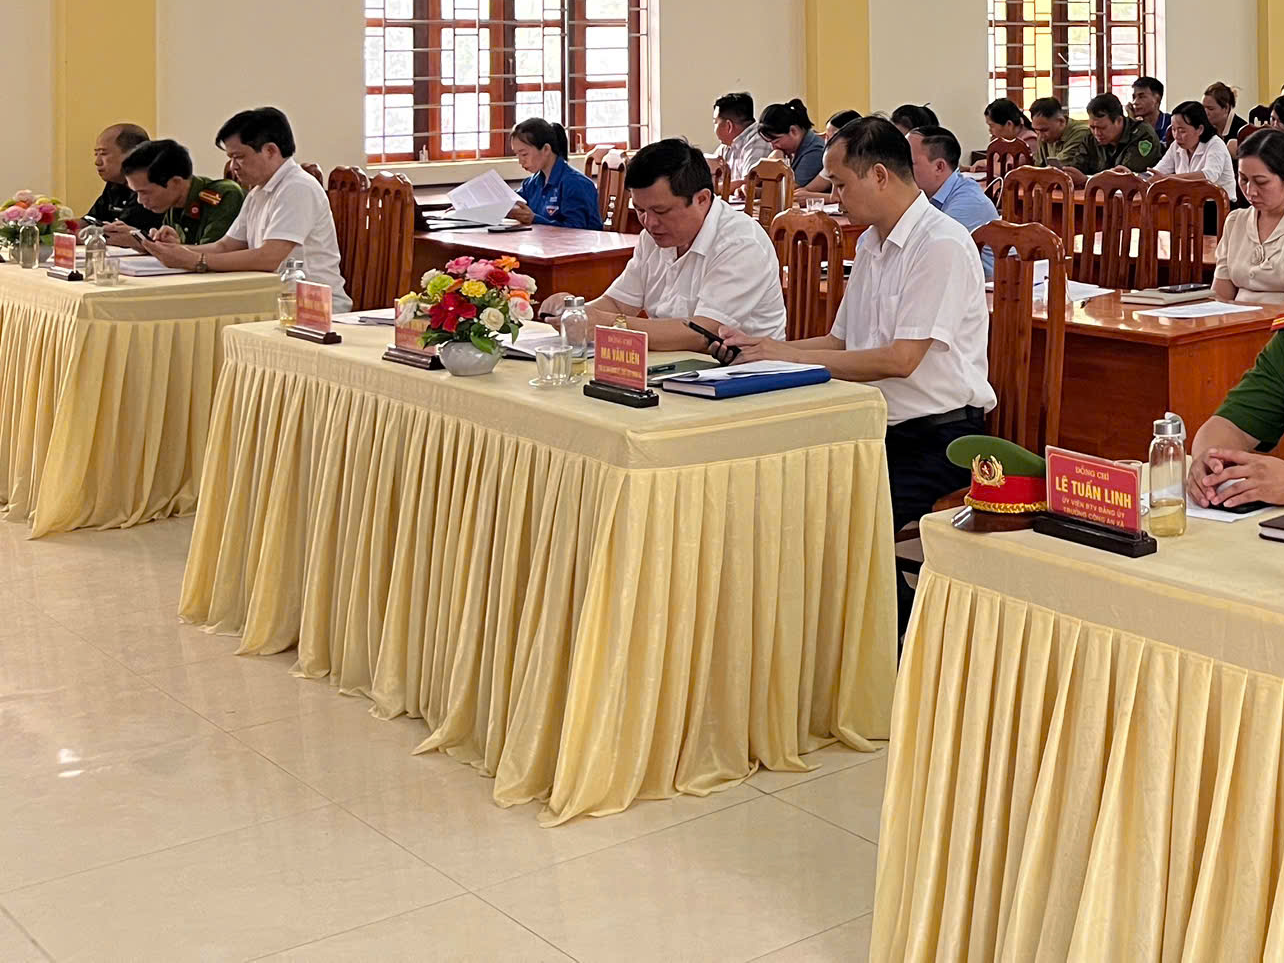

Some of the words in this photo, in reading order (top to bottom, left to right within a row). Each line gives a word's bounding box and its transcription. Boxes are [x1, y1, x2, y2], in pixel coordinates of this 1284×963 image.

[1055, 475, 1068, 493] LÊ
[1071, 479, 1102, 501] TUẤN
[1104, 488, 1132, 509] LINH
